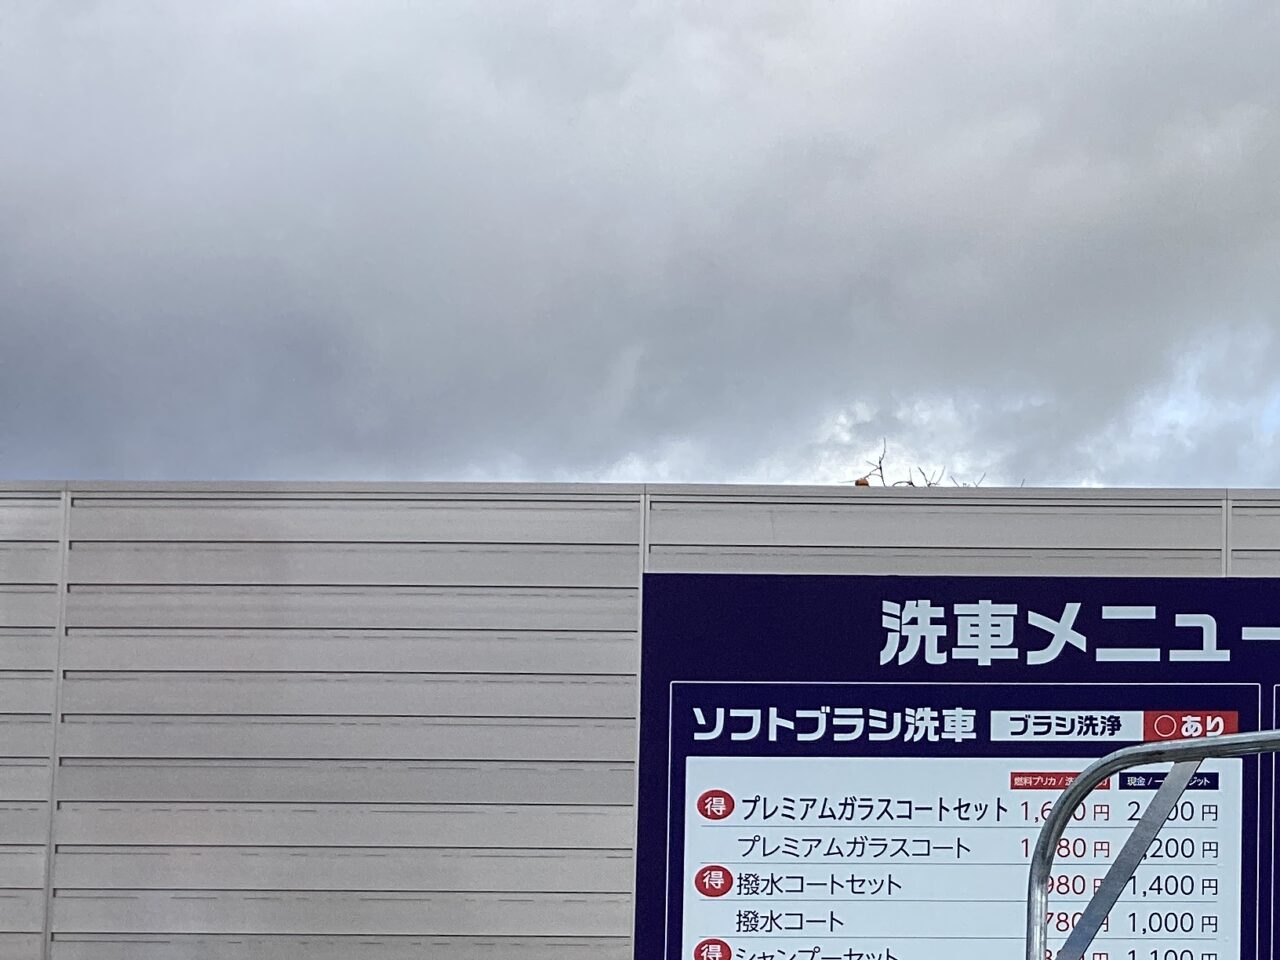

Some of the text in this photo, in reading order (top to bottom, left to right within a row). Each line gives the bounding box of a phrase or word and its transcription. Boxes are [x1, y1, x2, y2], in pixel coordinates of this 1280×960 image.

[692, 706, 977, 742] ソフトブラシ洗車
[1009, 714, 1122, 737] ブラシ洗浄
[1014, 776, 1057, 787] 燃料プリカ
[1127, 776, 1146, 787] 現金
[704, 797, 726, 815] 得
[741, 795, 1008, 822] プレミアムガラスコートセット
[738, 835, 971, 858] プレミアムガラスコート
[703, 871, 724, 889] 得
[736, 872, 902, 896] 撥水コートセット
[1128, 875, 1194, 897] 1,400
[735, 910, 844, 933] 撥水コート
[1128, 912, 1194, 934] 1,000
